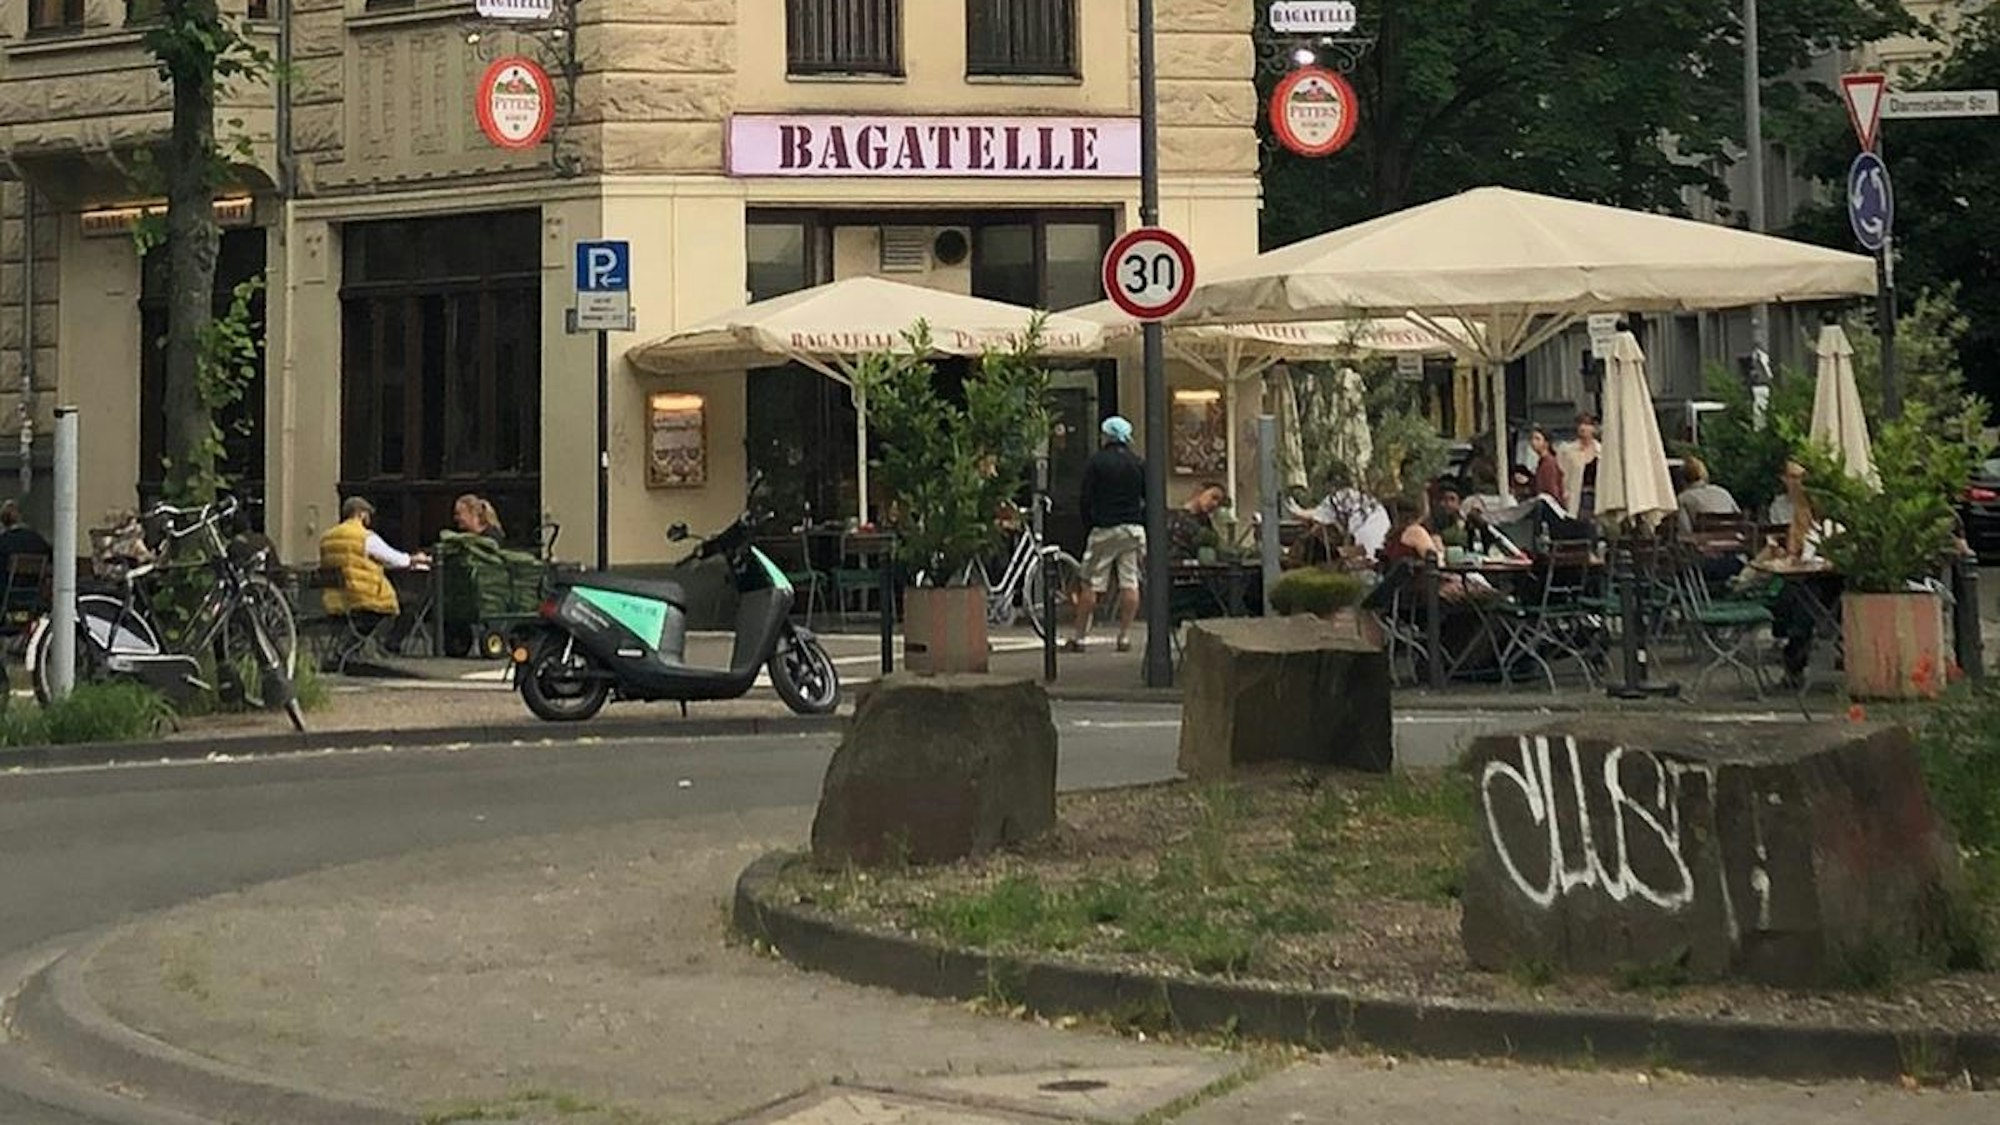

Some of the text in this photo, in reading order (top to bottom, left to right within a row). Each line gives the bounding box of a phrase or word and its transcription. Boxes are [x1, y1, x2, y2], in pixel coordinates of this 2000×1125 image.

[1273, 9, 1352, 22] BAGATELLE
[779, 125, 1099, 171] BAGATELLE
[1125, 254, 1174, 294] 30
